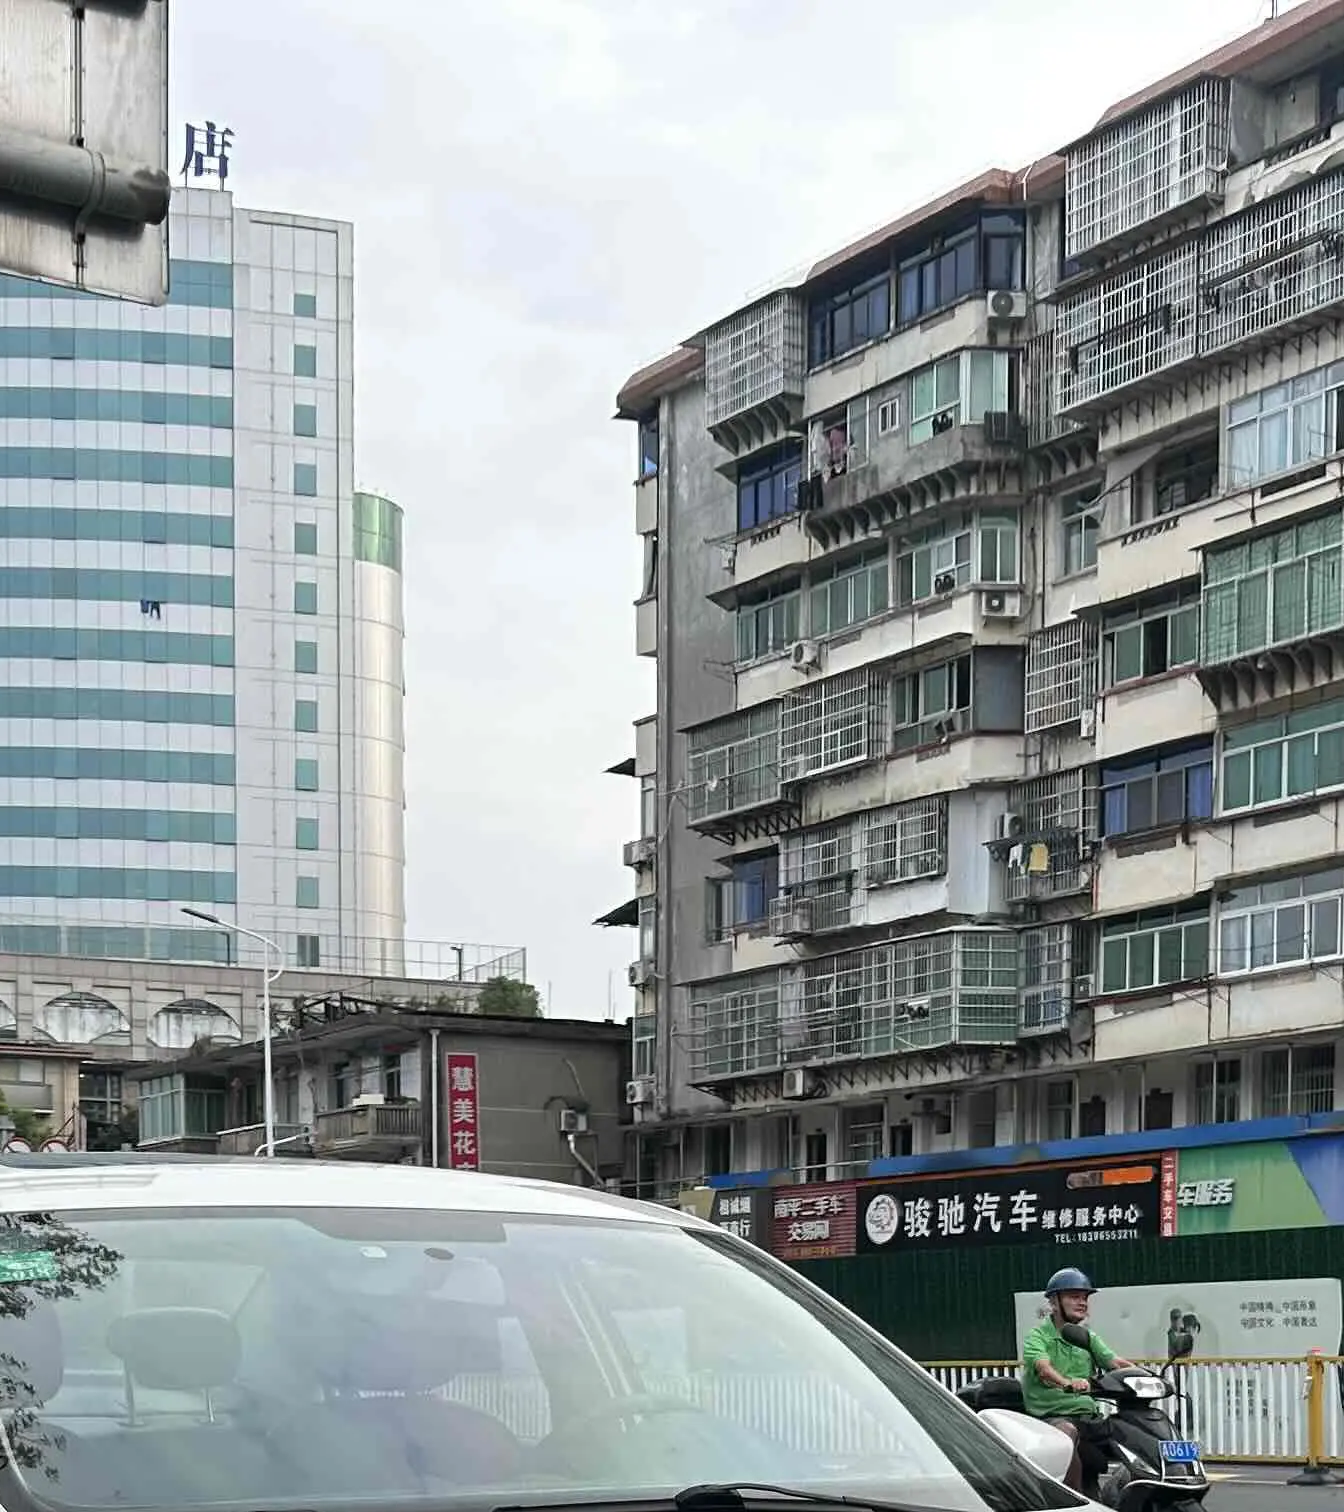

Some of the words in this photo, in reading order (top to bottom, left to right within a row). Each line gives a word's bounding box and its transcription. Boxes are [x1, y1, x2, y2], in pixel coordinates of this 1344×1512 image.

[181, 121, 235, 177] 店
[451, 1066, 476, 1170] 慧美花
[904, 1190, 1038, 1237] 骏驰汽车
[1042, 1204, 1139, 1229] 维修服务中心
